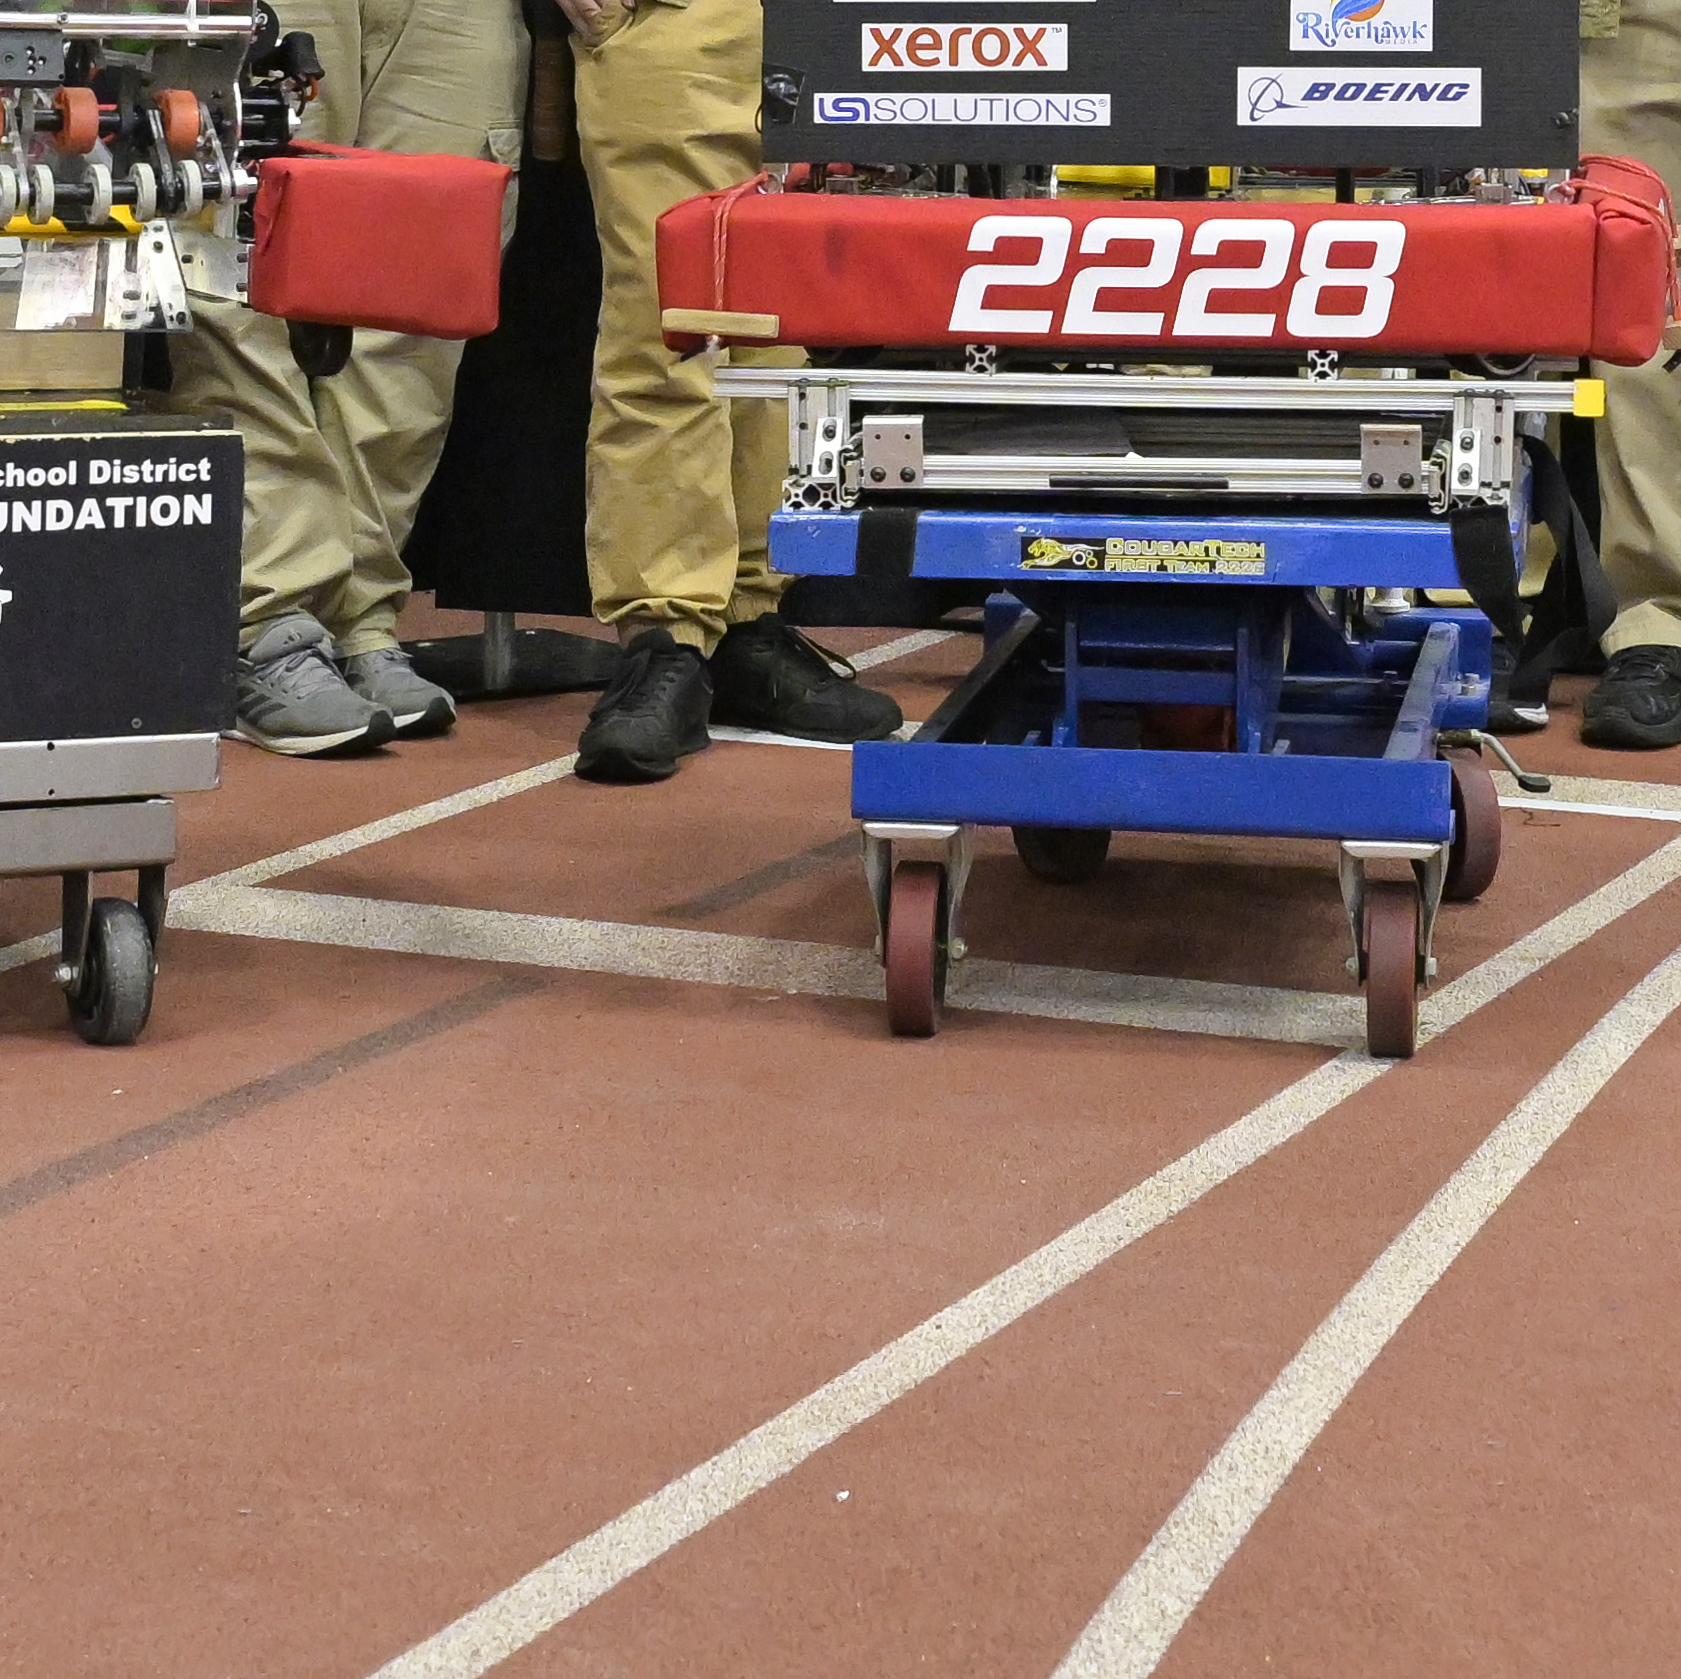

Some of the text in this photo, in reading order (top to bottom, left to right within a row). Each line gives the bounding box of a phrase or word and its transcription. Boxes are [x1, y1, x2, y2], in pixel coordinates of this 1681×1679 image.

[1296, 12, 1428, 48] Riverhawk
[868, 27, 1049, 67] xerox
[1300, 82, 1470, 102] BOEING
[948, 215, 1407, 338] 2228
[88, 457, 212, 486] District
[1105, 559, 1265, 575] FIRST TEAM 2228
